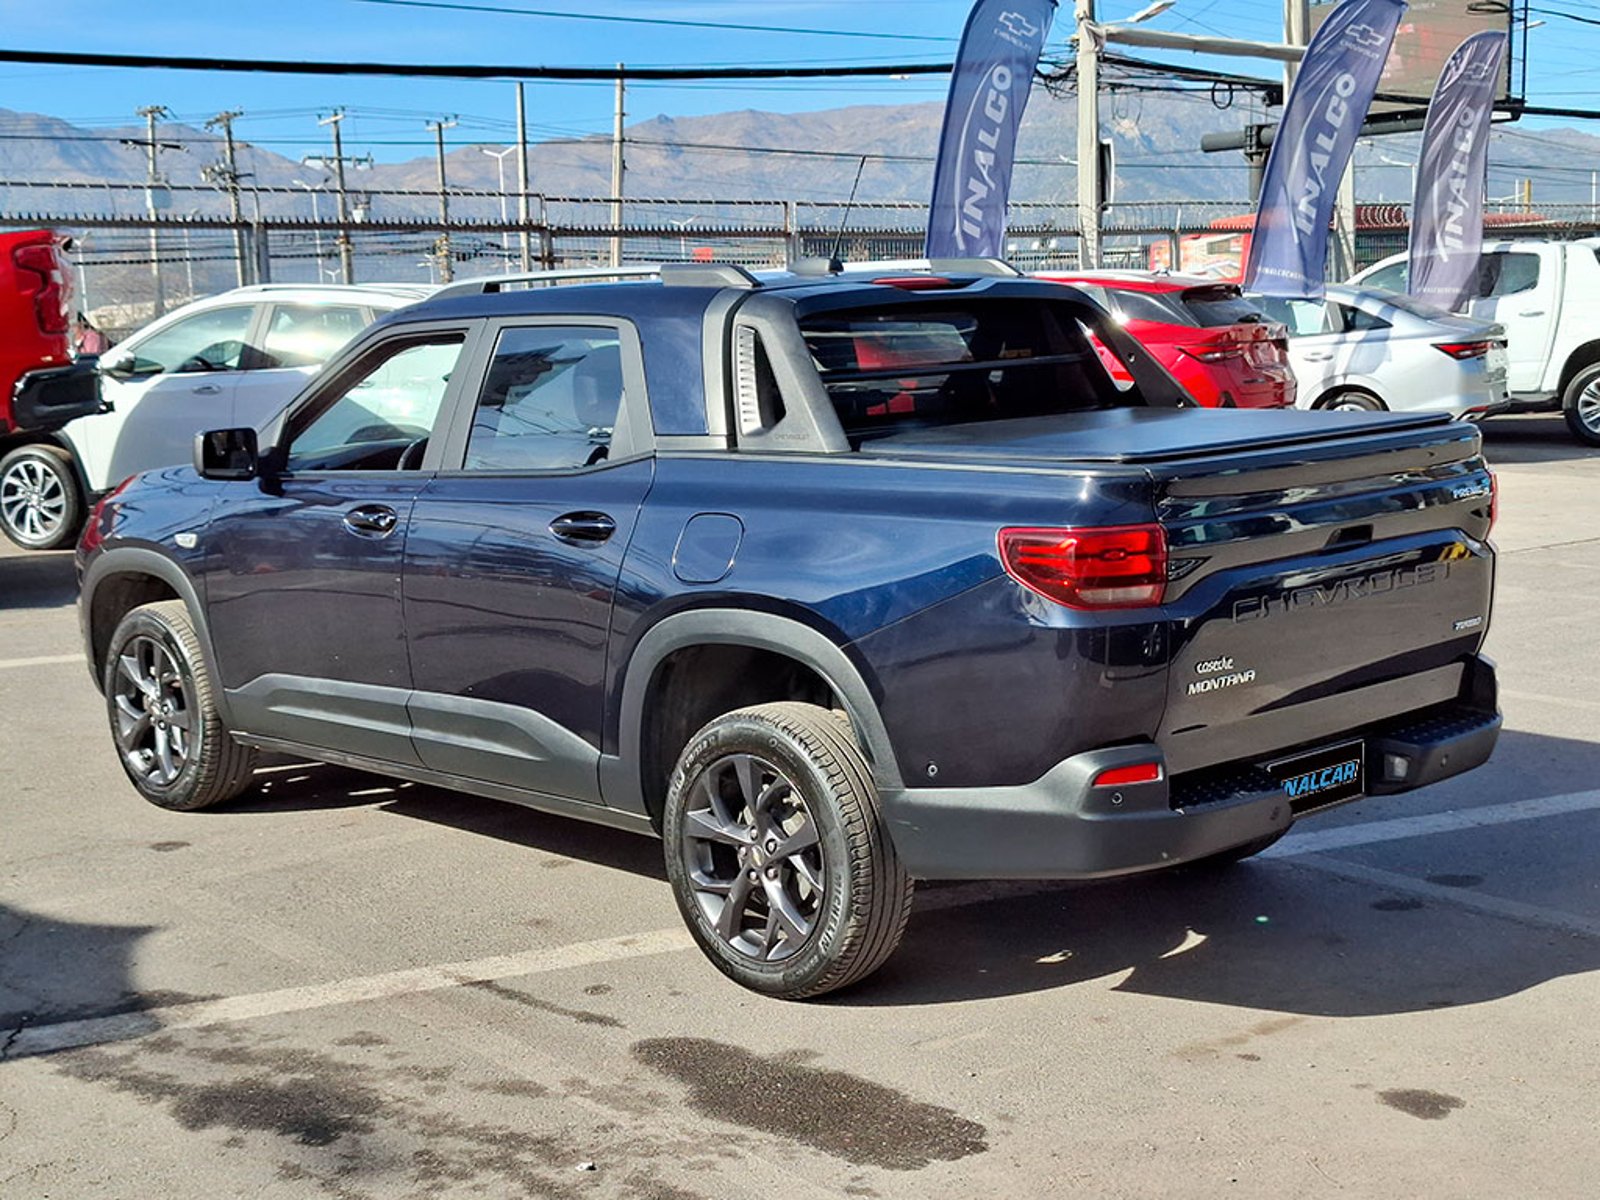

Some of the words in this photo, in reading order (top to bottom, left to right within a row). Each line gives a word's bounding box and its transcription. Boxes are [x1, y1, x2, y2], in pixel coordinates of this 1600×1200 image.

[962, 65, 1012, 239] INALCO
[1296, 72, 1356, 236] INALCO
[1444, 106, 1475, 250] INALCO
[1232, 562, 1451, 623] CHEVROLET
[1187, 669, 1256, 695] MONTANA
[1282, 762, 1357, 797] NALCAR
